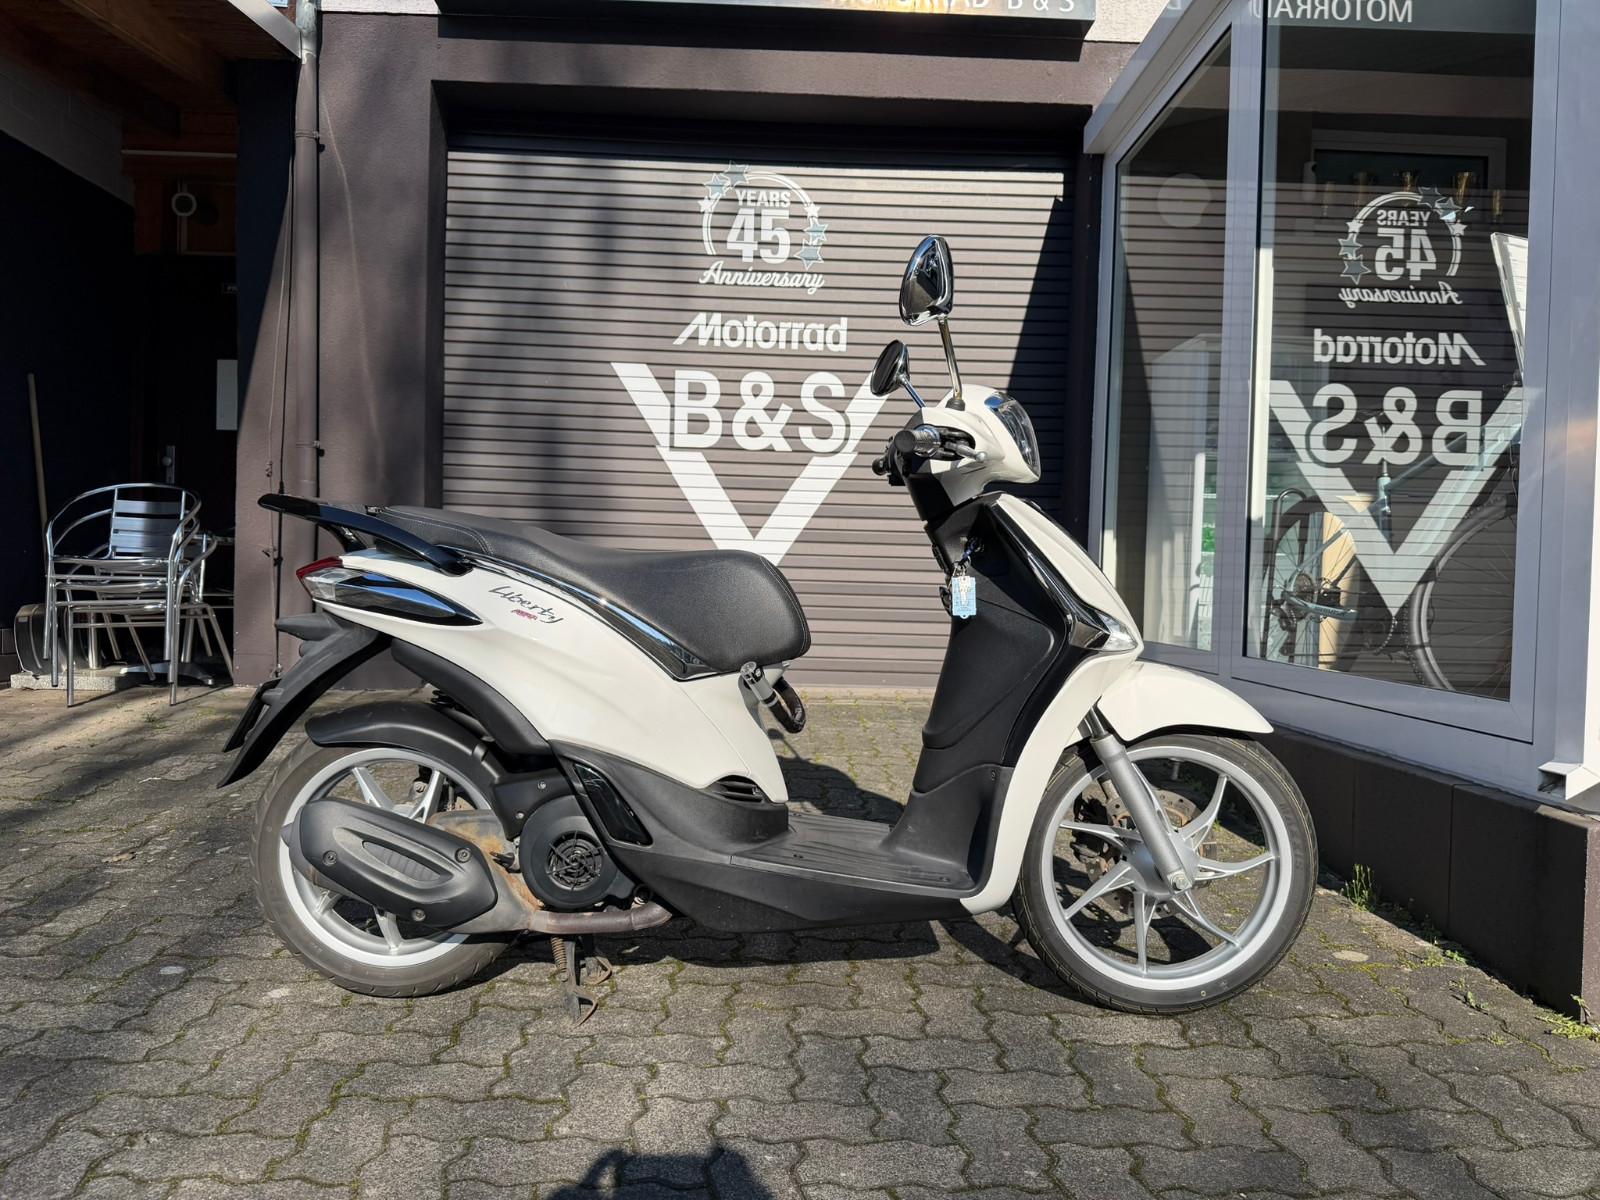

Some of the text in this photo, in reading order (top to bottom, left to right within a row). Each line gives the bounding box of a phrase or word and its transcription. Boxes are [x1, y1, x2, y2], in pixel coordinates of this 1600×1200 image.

[735, 189, 791, 208] YEARS
[726, 208, 791, 264] 45
[698, 260, 825, 295] Anniversary
[672, 312, 848, 352] Motorrad
[673, 369, 848, 453] B&S
[488, 586, 564, 624] Liberty
